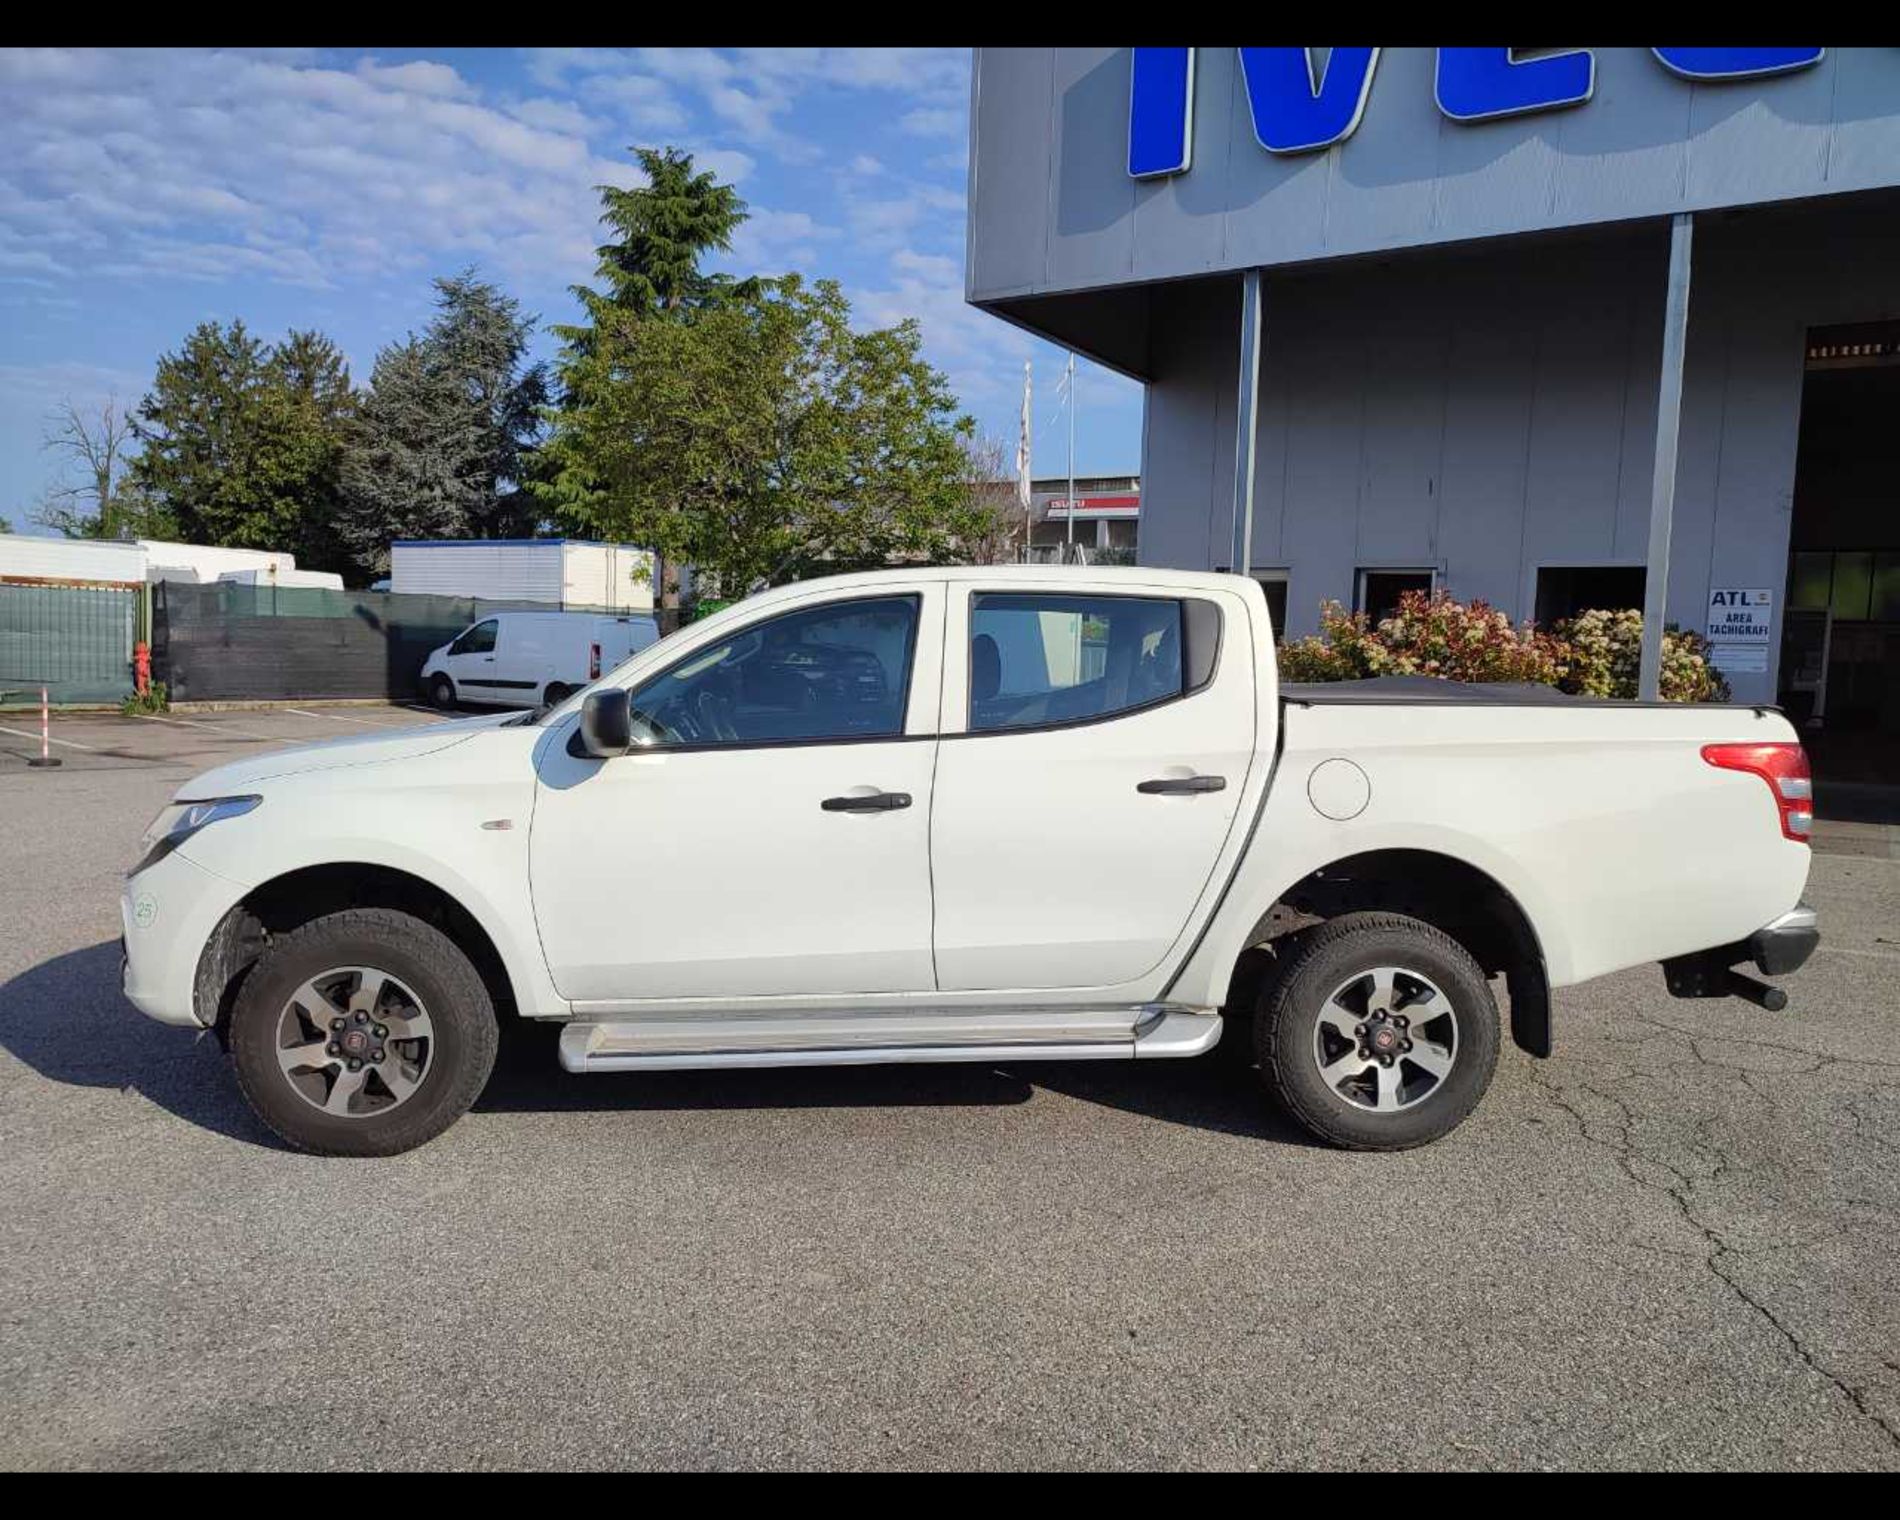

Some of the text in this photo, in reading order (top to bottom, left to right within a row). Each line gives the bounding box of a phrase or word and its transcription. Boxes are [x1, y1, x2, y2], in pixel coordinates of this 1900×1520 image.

[1711, 591, 1751, 607] ATL
[1725, 613, 1753, 623] AREA
[1709, 624, 1769, 636] TACHIGRAFI
